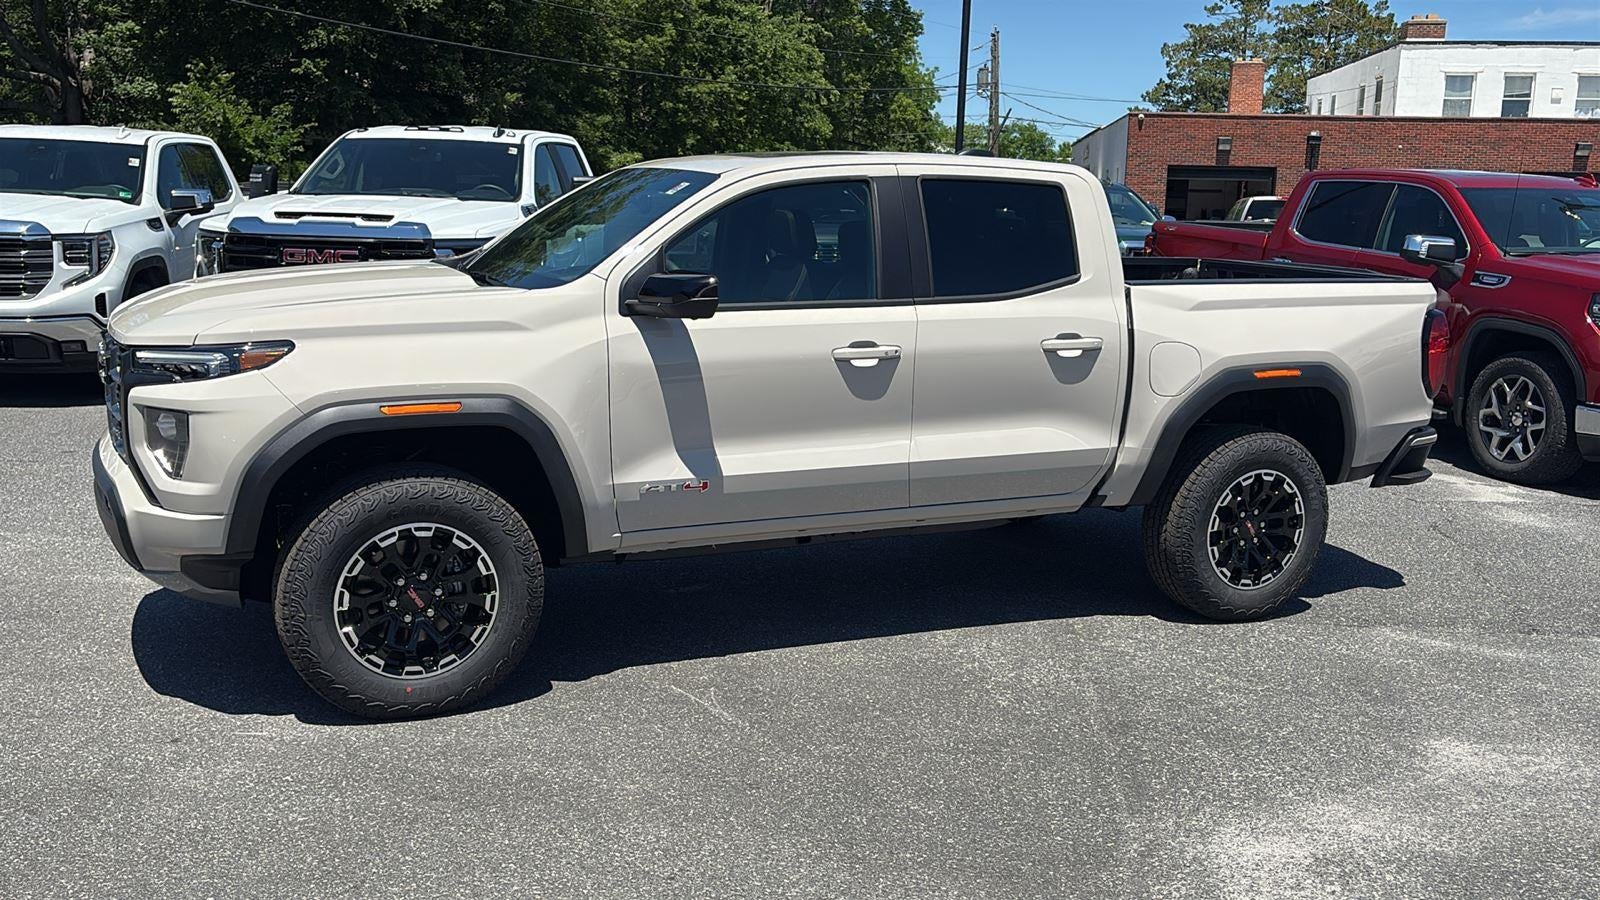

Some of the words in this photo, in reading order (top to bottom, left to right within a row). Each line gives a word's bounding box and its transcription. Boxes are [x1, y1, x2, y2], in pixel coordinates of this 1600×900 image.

[283, 248, 359, 263] GMC
[640, 480, 709, 493] AT4
[407, 587, 425, 608] GMC
